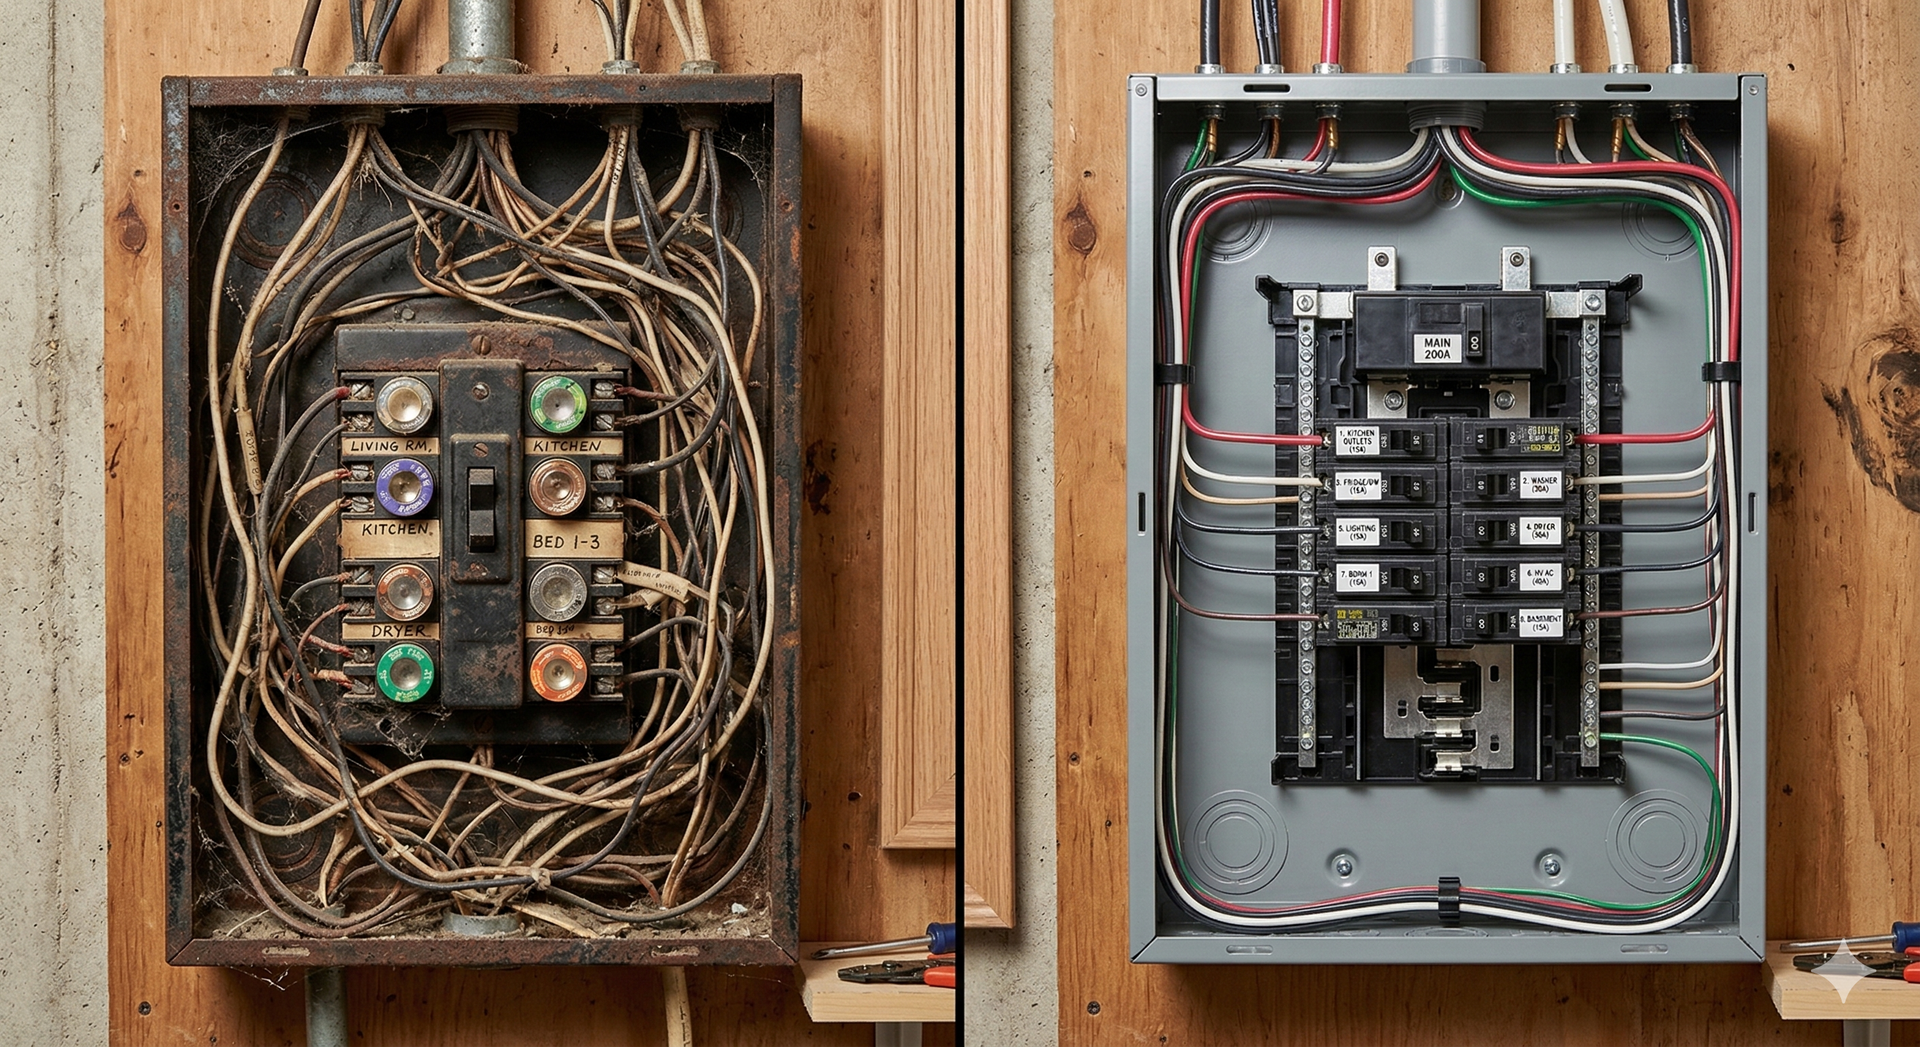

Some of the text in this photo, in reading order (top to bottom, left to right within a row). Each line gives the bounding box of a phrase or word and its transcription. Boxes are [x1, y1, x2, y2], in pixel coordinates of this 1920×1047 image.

[1424, 338, 1451, 347] MAIN
[1424, 350, 1451, 359] 200A
[533, 440, 602, 452] KITCHEN
[1343, 437, 1373, 445] OUTLETS
[350, 441, 399, 452] LIVING
[1345, 524, 1376, 532] LIGHTING
[533, 534, 600, 549] BED 1-3
[372, 624, 428, 638] DRYER
